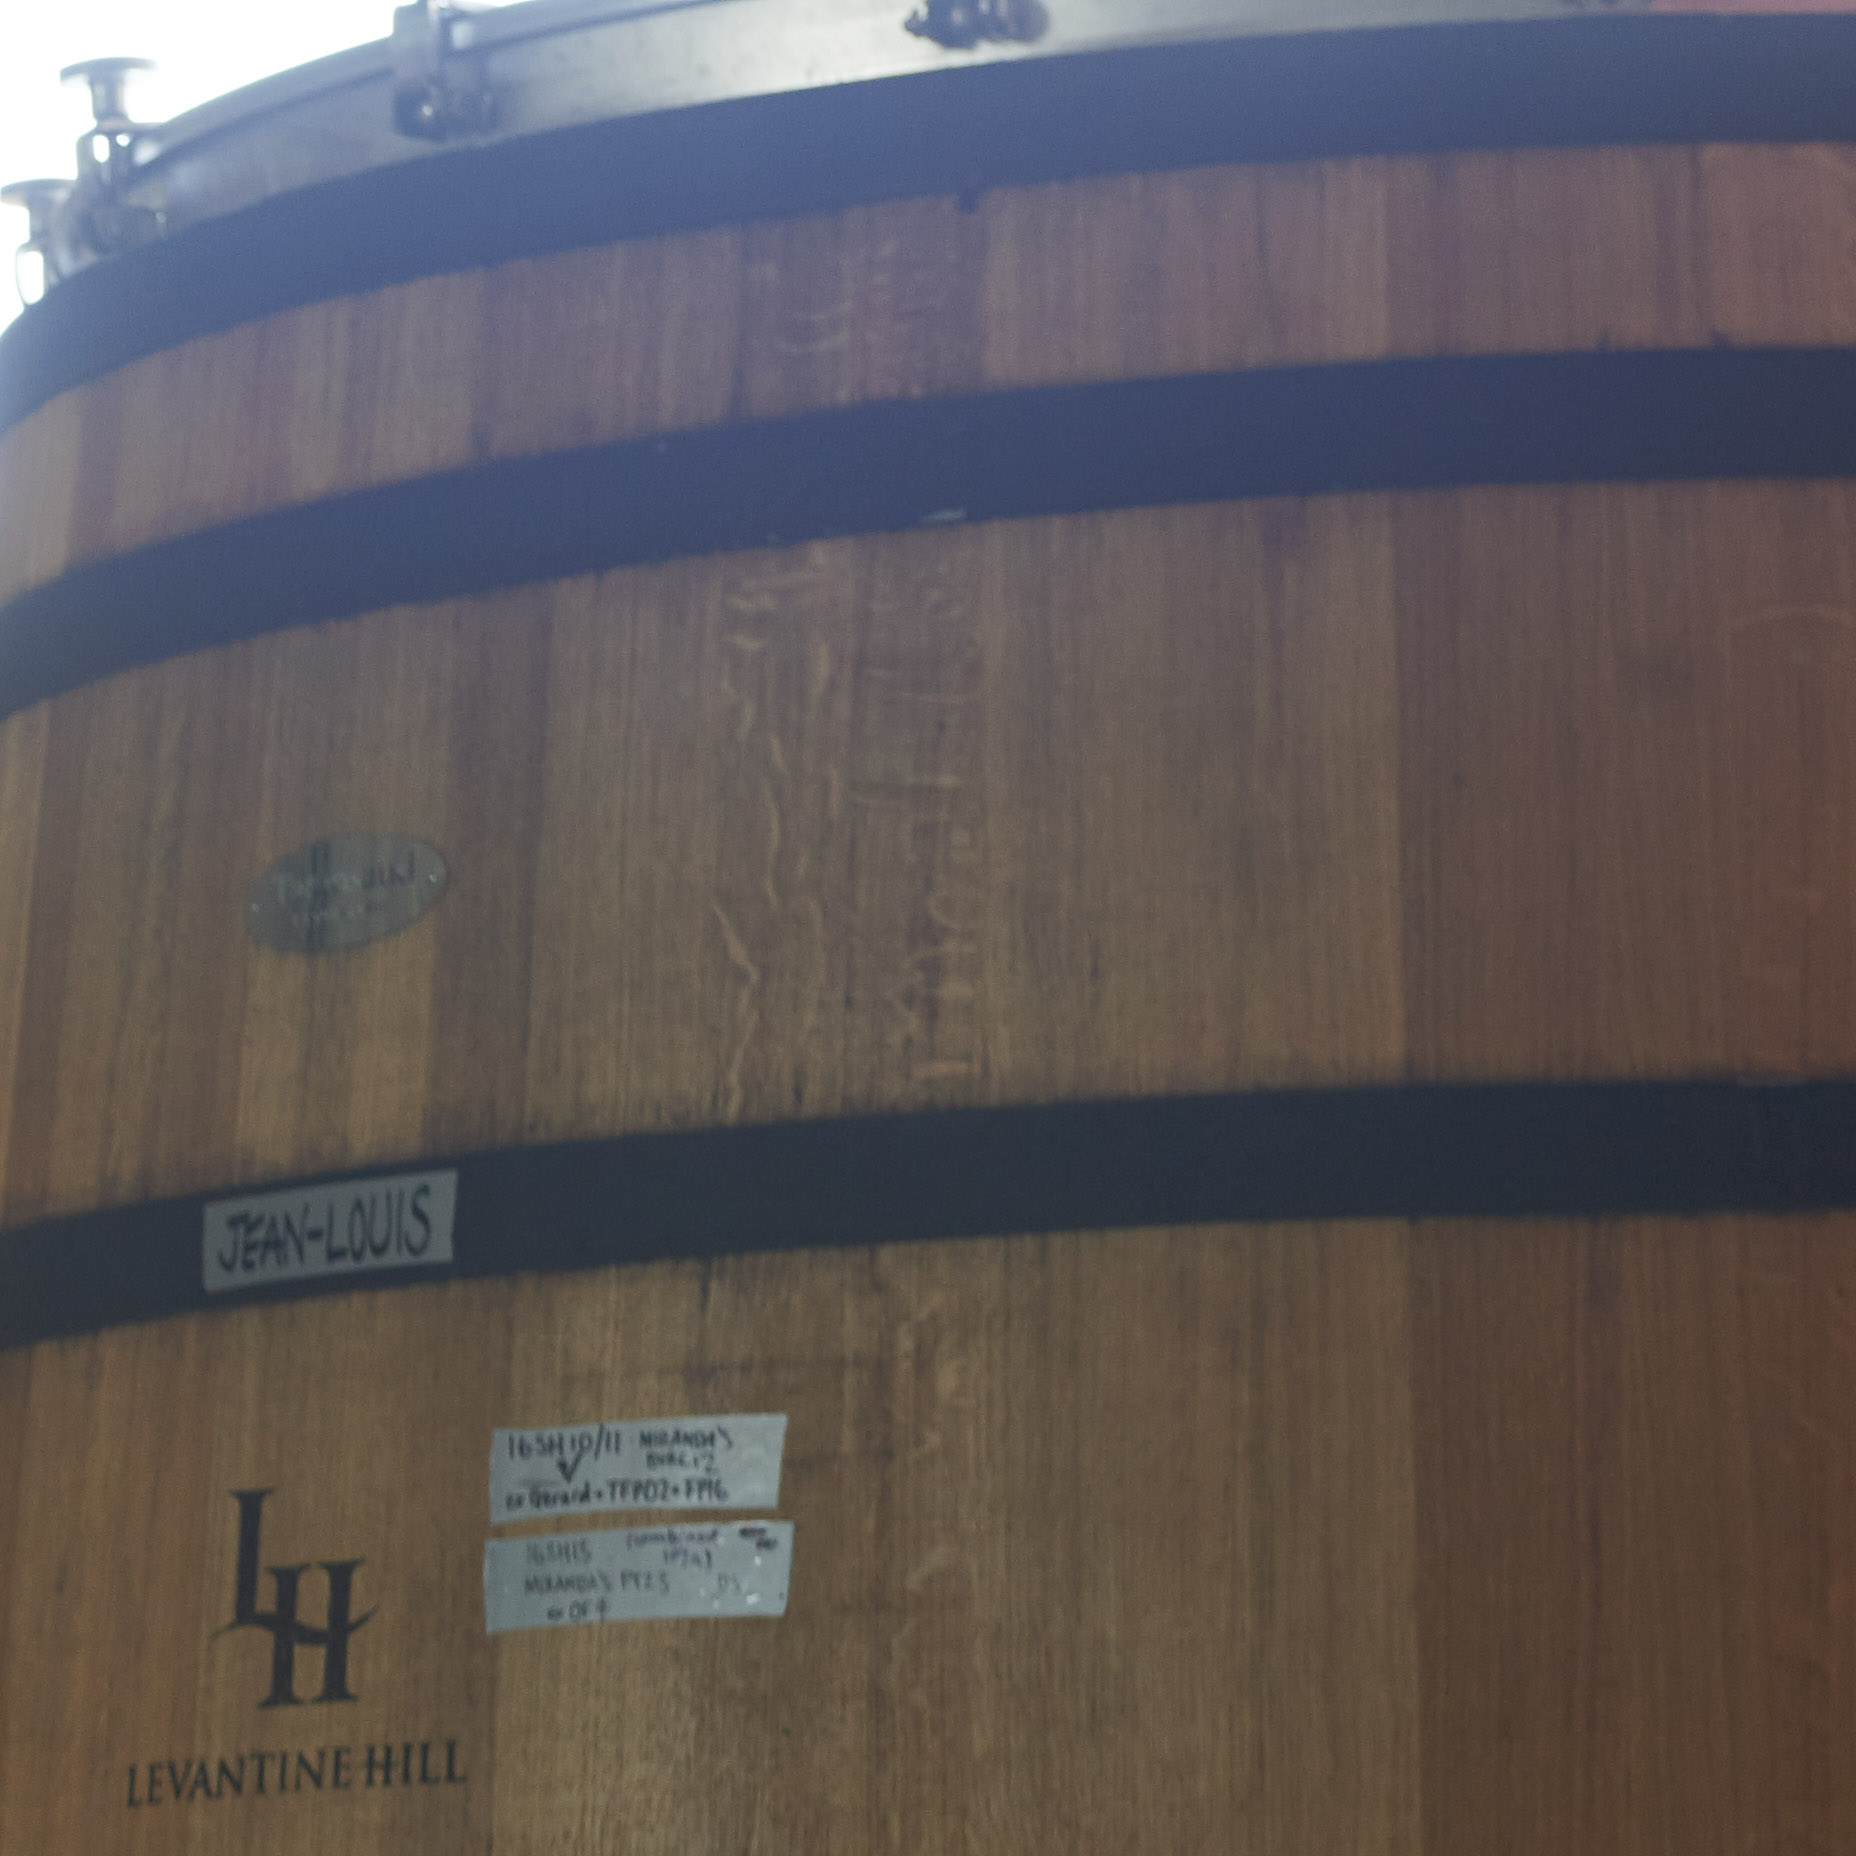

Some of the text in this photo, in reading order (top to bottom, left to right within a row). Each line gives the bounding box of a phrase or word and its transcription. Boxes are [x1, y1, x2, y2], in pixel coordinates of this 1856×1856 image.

[218, 1183, 431, 1273] JEAN-LOUIS
[127, 1739, 468, 1808] LEVANTINE HILL
